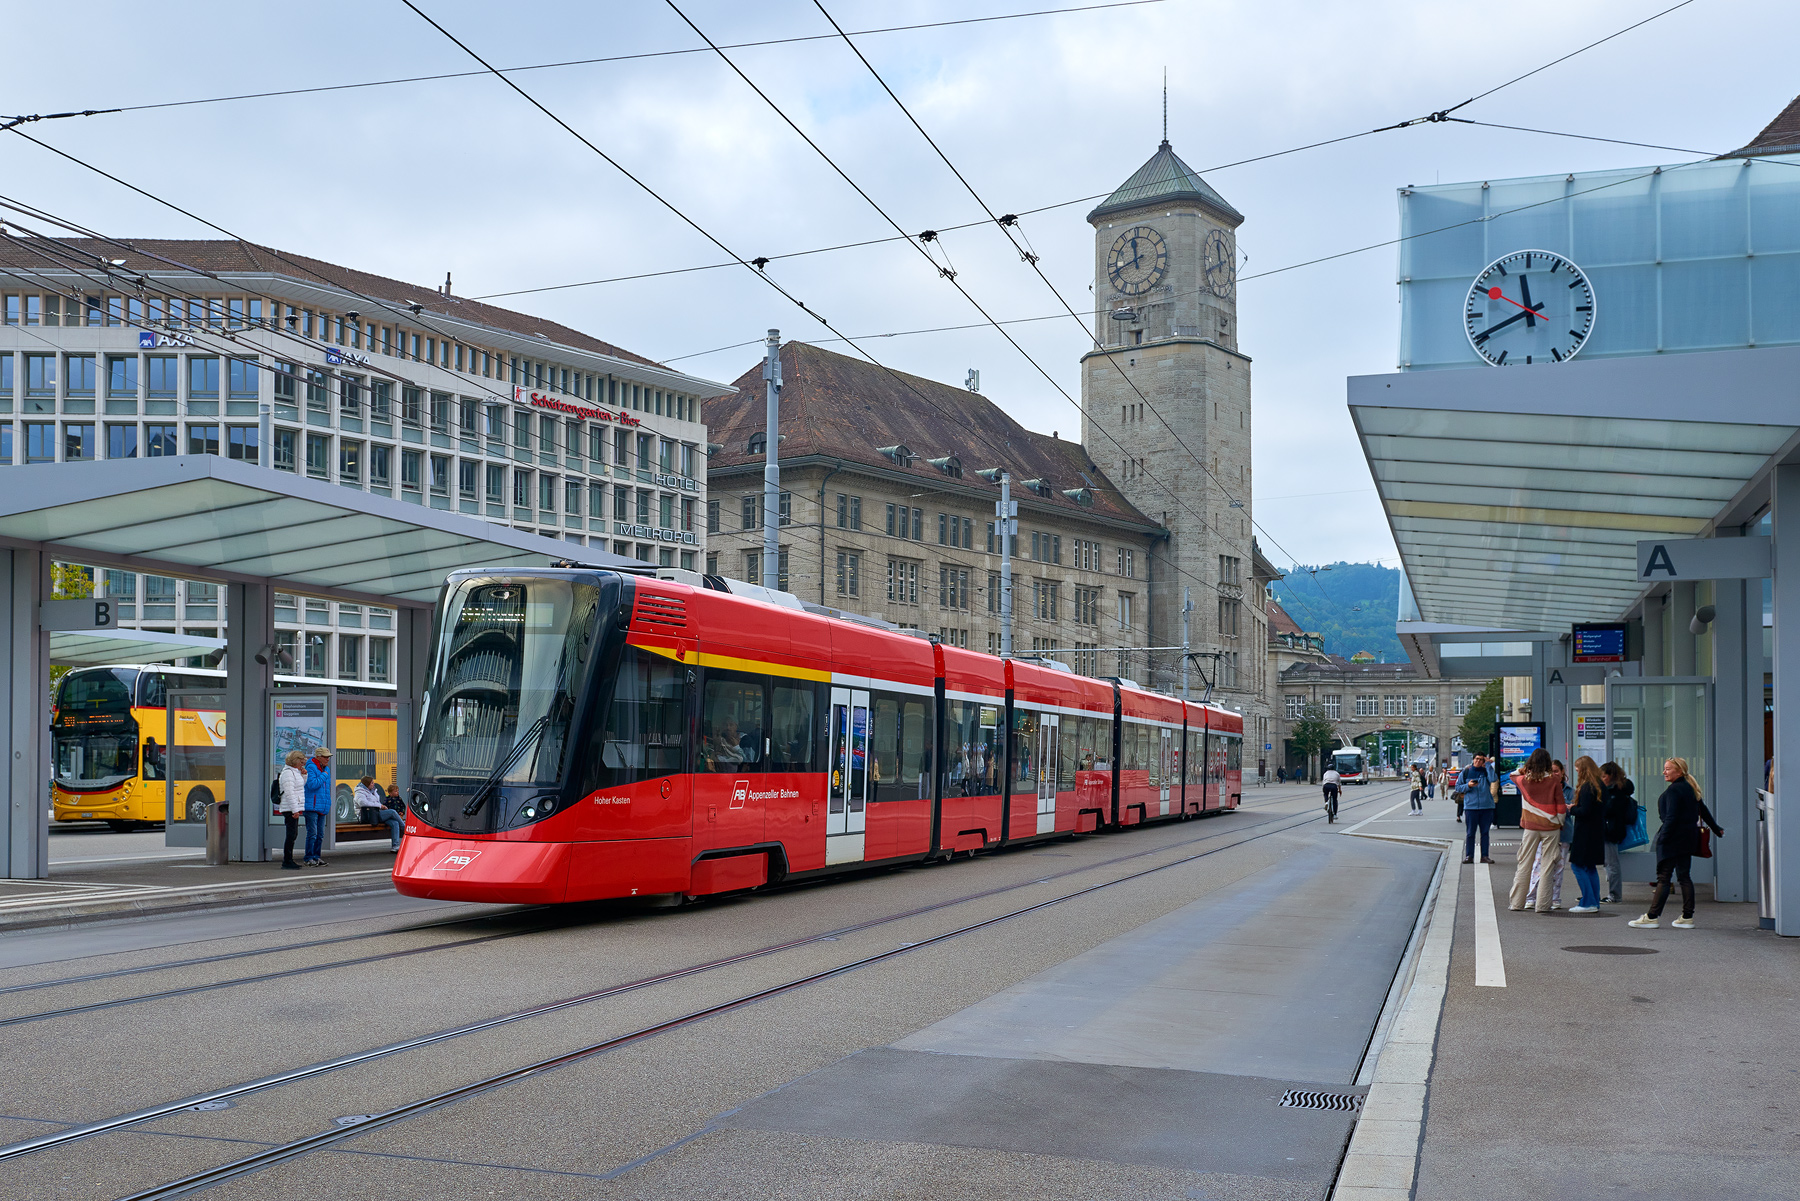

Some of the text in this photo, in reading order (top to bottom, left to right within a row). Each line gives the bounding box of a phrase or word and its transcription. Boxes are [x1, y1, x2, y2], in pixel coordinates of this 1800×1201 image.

[156, 333, 195, 347] AXA
[531, 392, 613, 421] Schützengarten
[620, 411, 641, 427] Bier
[655, 474, 700, 492] HOTEL
[620, 524, 701, 545] METROPOL
[1643, 545, 1677, 577] A
[95, 602, 111, 626] B
[1549, 669, 1564, 684] A
[594, 795, 631, 805] Hoher Kasten
[734, 788, 800, 801] AB Appenzeller Bahnen
[406, 825, 417, 834] 4104
[444, 855, 471, 865] AB
